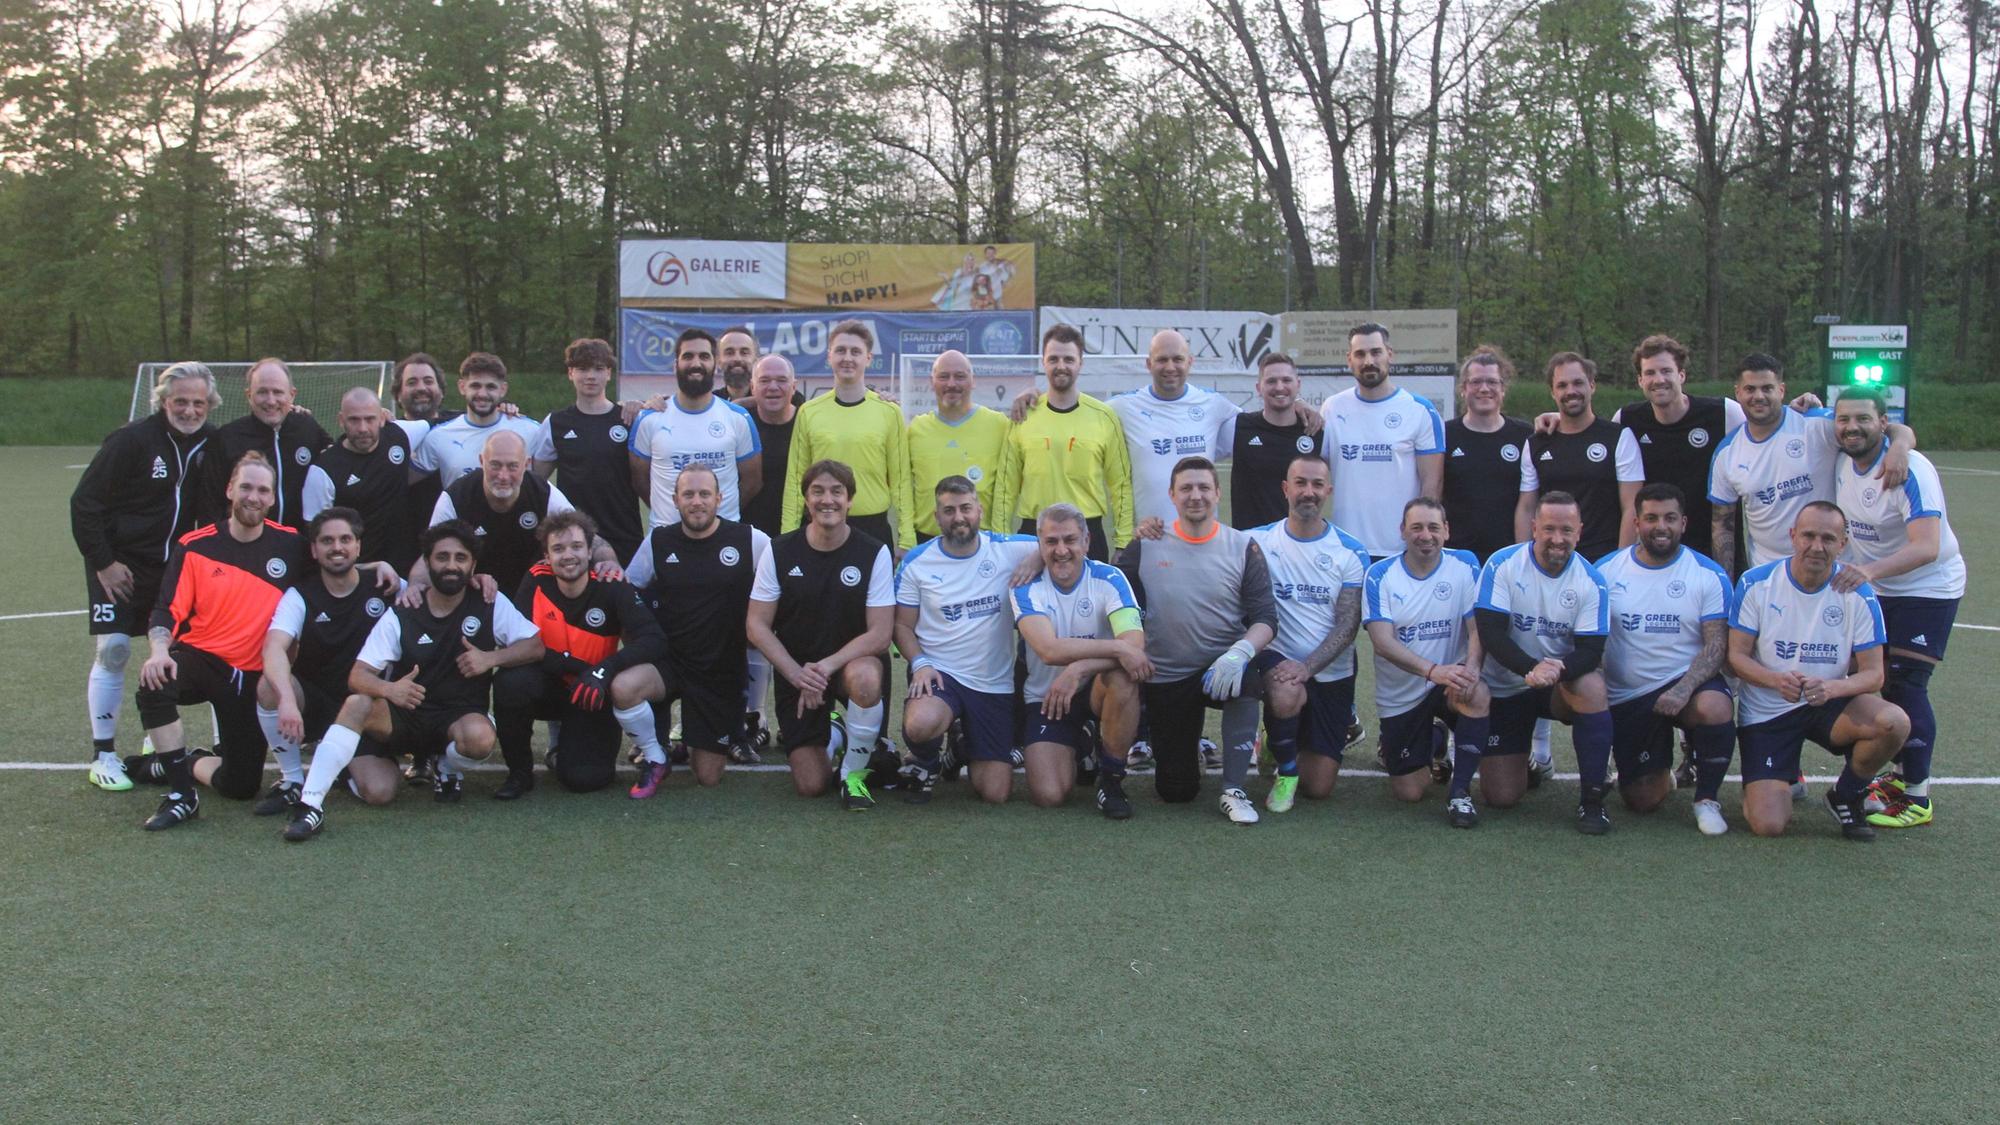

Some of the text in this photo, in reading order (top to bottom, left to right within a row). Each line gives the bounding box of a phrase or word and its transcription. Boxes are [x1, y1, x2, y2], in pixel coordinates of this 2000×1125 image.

[690, 258, 761, 273] GALERIE
[820, 250, 871, 270] SHOP!
[824, 269, 869, 289] DICH!
[826, 282, 898, 305] HAPPY!
[1832, 351, 1857, 360] HEIM
[1878, 351, 1903, 360] GAST
[1175, 435, 1205, 444] GREEK
[695, 452, 725, 460] GREEK
[152, 466, 168, 478] 25
[1777, 474, 1810, 490] GREEK
[1296, 584, 1330, 594] GREEK
[966, 594, 1000, 608] GREEK
[93, 603, 115, 622] 25
[1645, 614, 1680, 622] GREEK
[1418, 619, 1452, 630] GREEK
[1537, 616, 1570, 630] GREEK
[1800, 643, 1838, 652] GREEK
[1040, 725, 1047, 734] 7
[1766, 757, 1773, 768] 4
